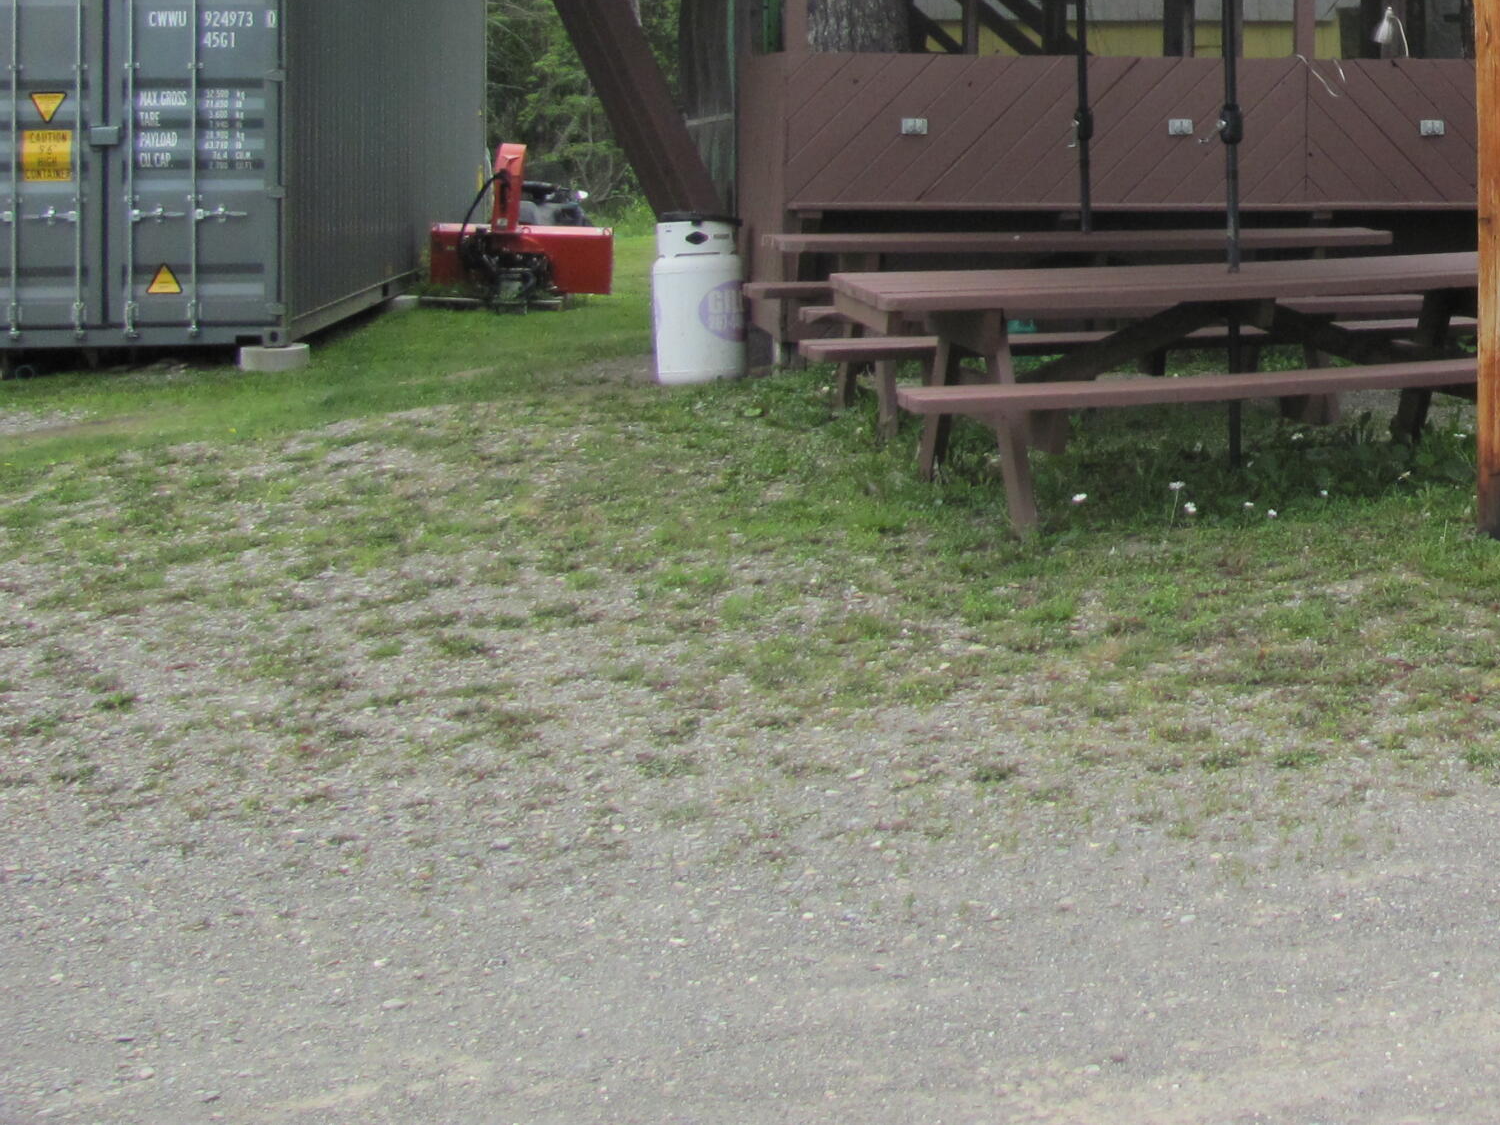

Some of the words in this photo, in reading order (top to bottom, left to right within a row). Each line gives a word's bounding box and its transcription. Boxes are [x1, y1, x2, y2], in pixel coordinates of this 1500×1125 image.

[148, 11, 187, 27] CWWU
[204, 11, 254, 27] 924973
[204, 32, 236, 47] 45G1
[140, 111, 161, 127] TARE
[30, 130, 67, 143] CAUTION
[140, 131, 178, 148] PAYLOAD
